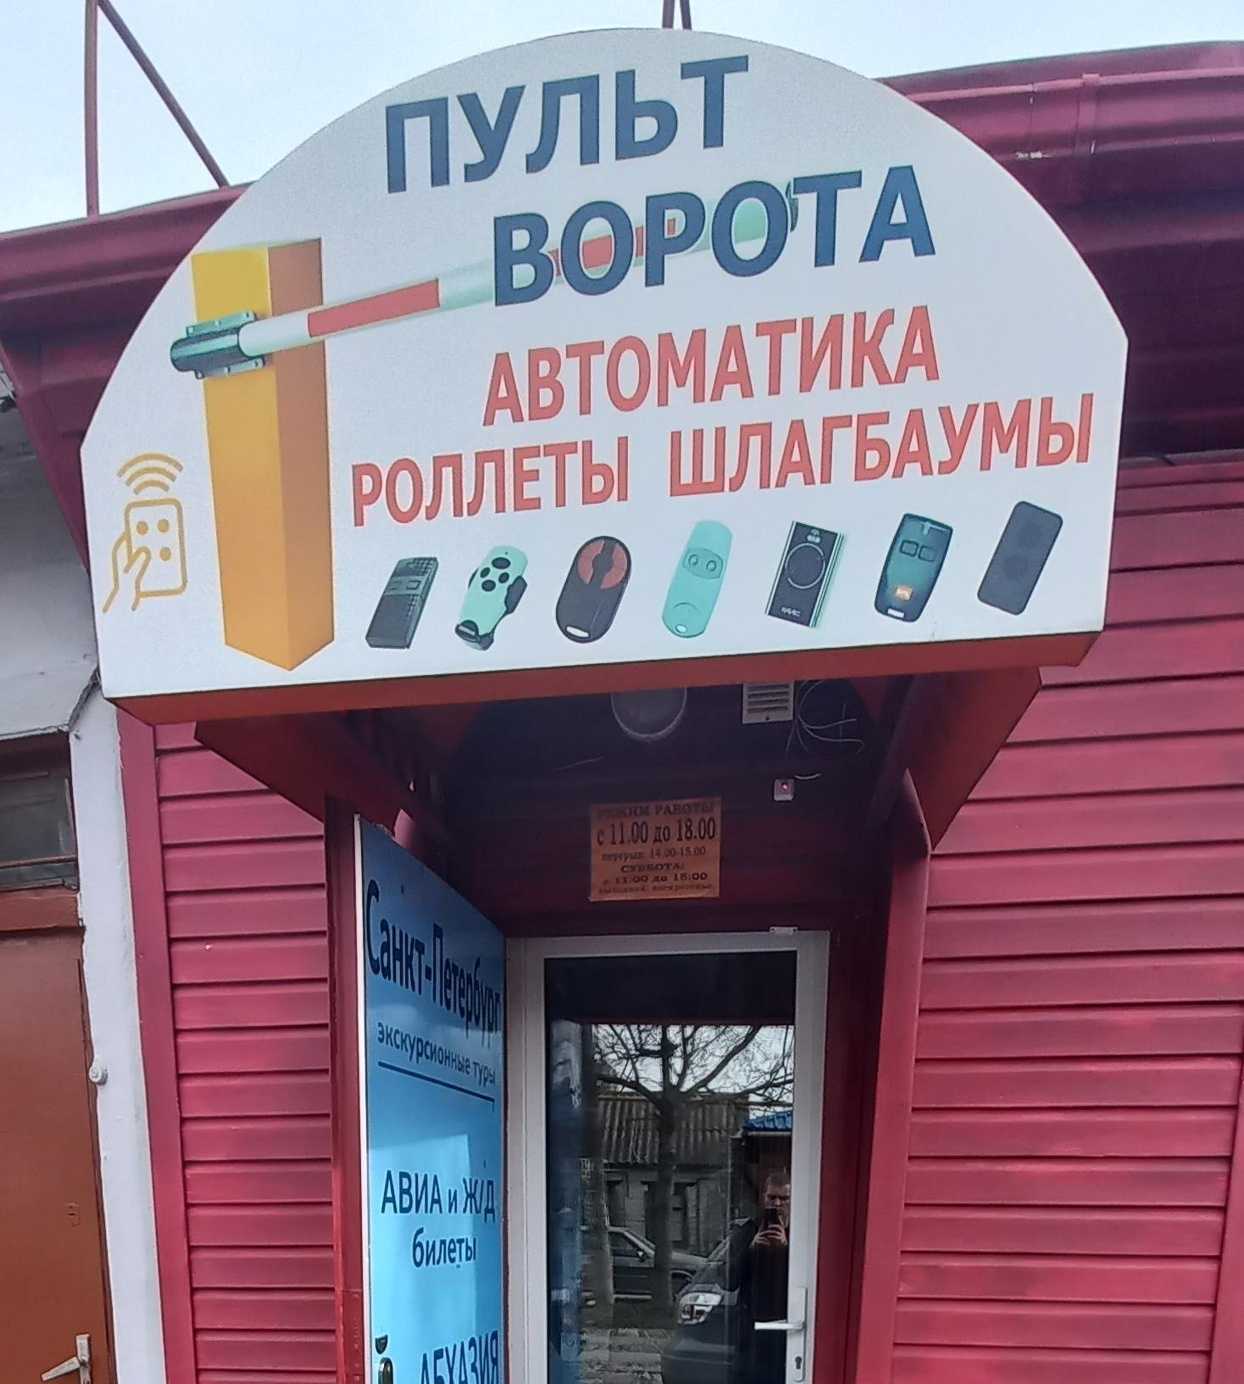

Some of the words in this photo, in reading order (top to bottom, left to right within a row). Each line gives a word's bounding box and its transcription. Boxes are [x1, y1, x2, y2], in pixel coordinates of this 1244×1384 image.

[385, 55, 750, 194] ПУЛЬТ
[493, 165, 936, 307] ВОРОТА
[482, 305, 940, 427] АВТОМАТИКА
[352, 436, 629, 527] РОЛЛЕТЫ
[669, 392, 1094, 497] ШЛАГБАУМЫ
[611, 821, 648, 845] 11.00
[653, 825, 671, 843] до
[676, 816, 716, 841] 18.00
[366, 880, 501, 1048] Санкт-Петербург
[377, 1022, 471, 1072] экскурсионные
[473, 1061, 496, 1087] туры
[381, 1170, 442, 1214] АВИА
[448, 1189, 458, 1214] и
[463, 1177, 496, 1223] Ж/Д
[413, 1227, 476, 1268] билеты
